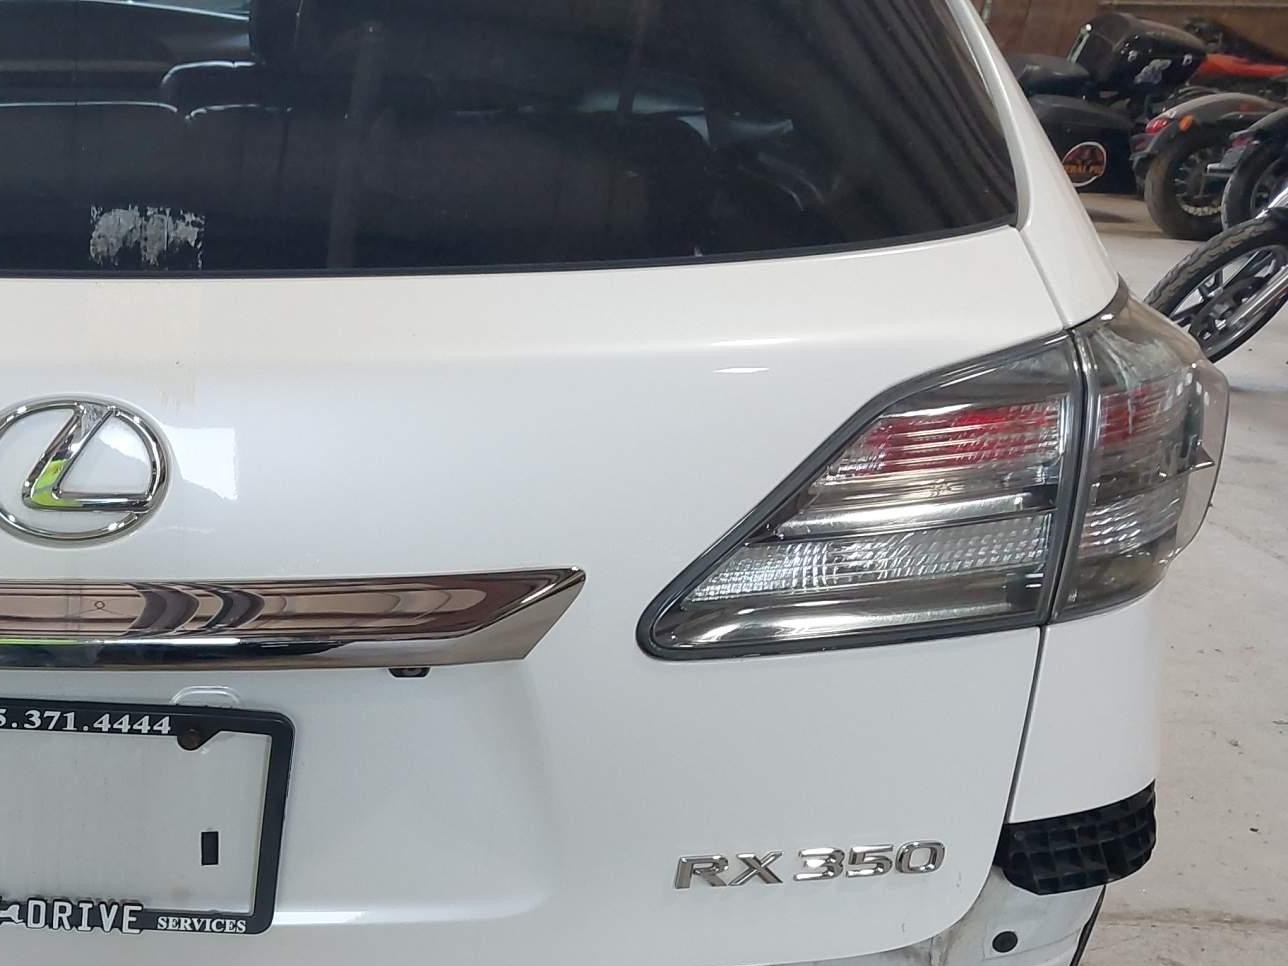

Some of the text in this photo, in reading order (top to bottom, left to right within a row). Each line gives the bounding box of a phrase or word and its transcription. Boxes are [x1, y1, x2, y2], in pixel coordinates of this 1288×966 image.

[673, 839, 947, 889] RX 350
[26, 898, 143, 935] DRIVE
[156, 915, 248, 934] SERVICES
